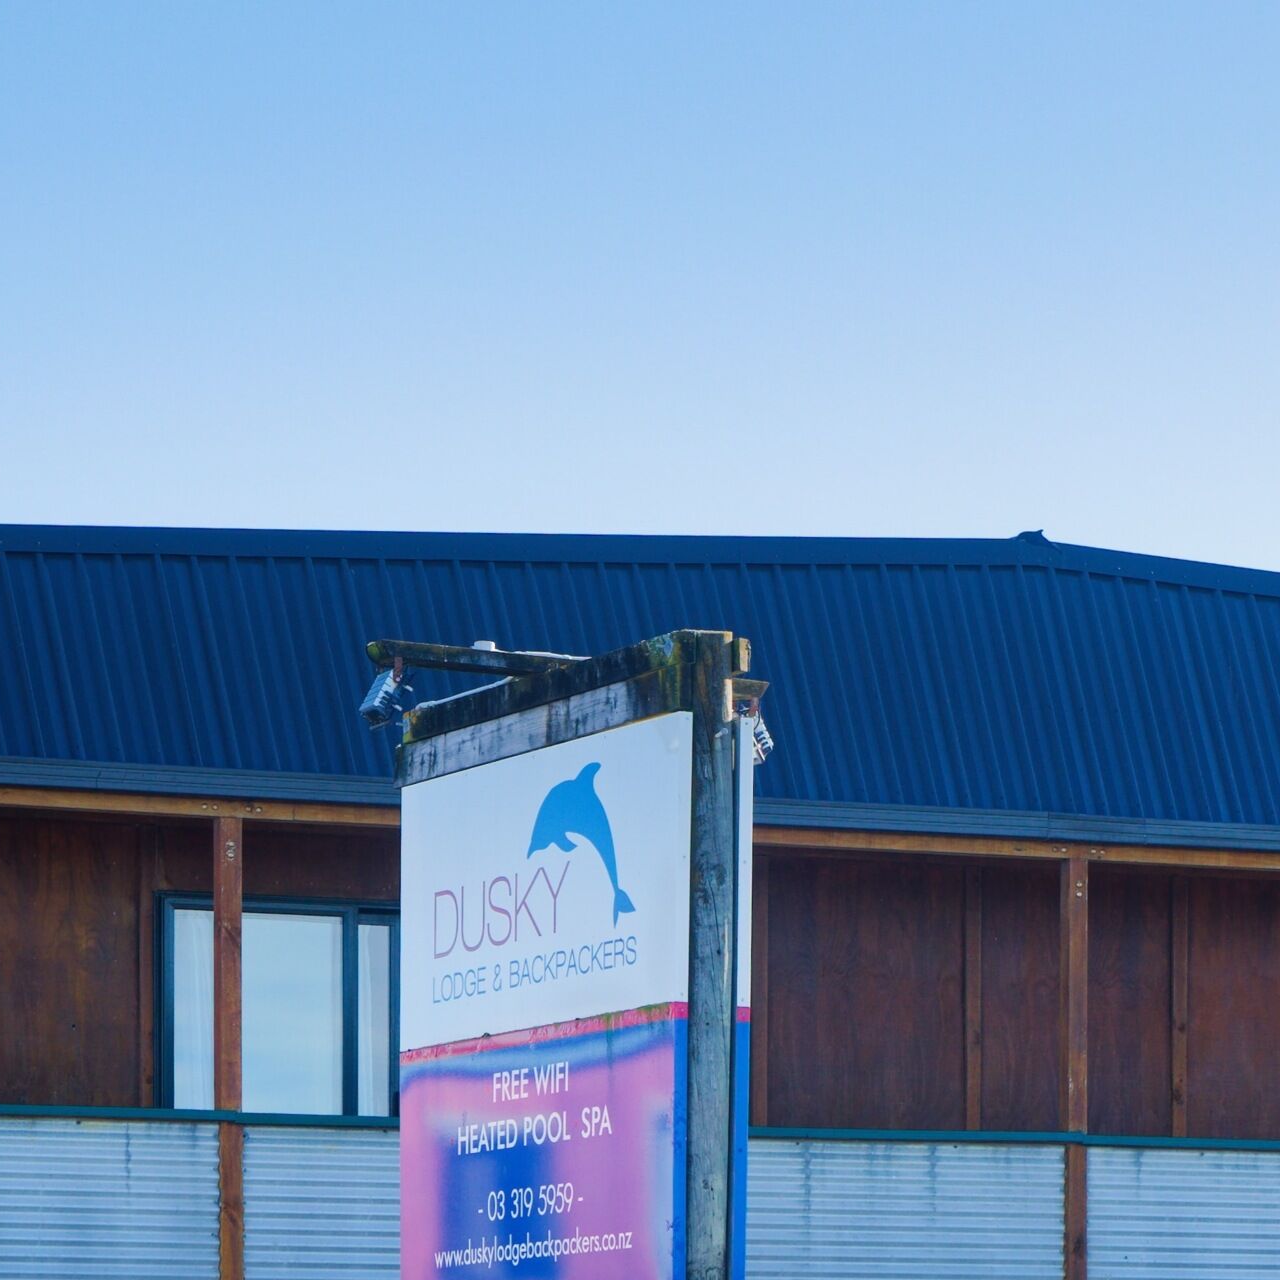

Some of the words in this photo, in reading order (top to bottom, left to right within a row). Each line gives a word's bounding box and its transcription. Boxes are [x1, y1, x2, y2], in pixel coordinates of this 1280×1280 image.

[433, 860, 570, 960] DUSKY
[432, 966, 487, 1004] LODGE
[492, 963, 503, 992] &
[509, 936, 638, 988] BACKPACKERS
[492, 1067, 529, 1103] FREE
[534, 1061, 569, 1097] WIFI
[457, 1118, 518, 1155] HEATED
[523, 1111, 571, 1146] POOL
[581, 1104, 613, 1138] SPA
[487, 1190, 506, 1221] 03
[510, 1187, 534, 1218] 319
[537, 1182, 574, 1216] 5959
[434, 1226, 633, 1269] www.duskylodgebackpackers.co.nz
